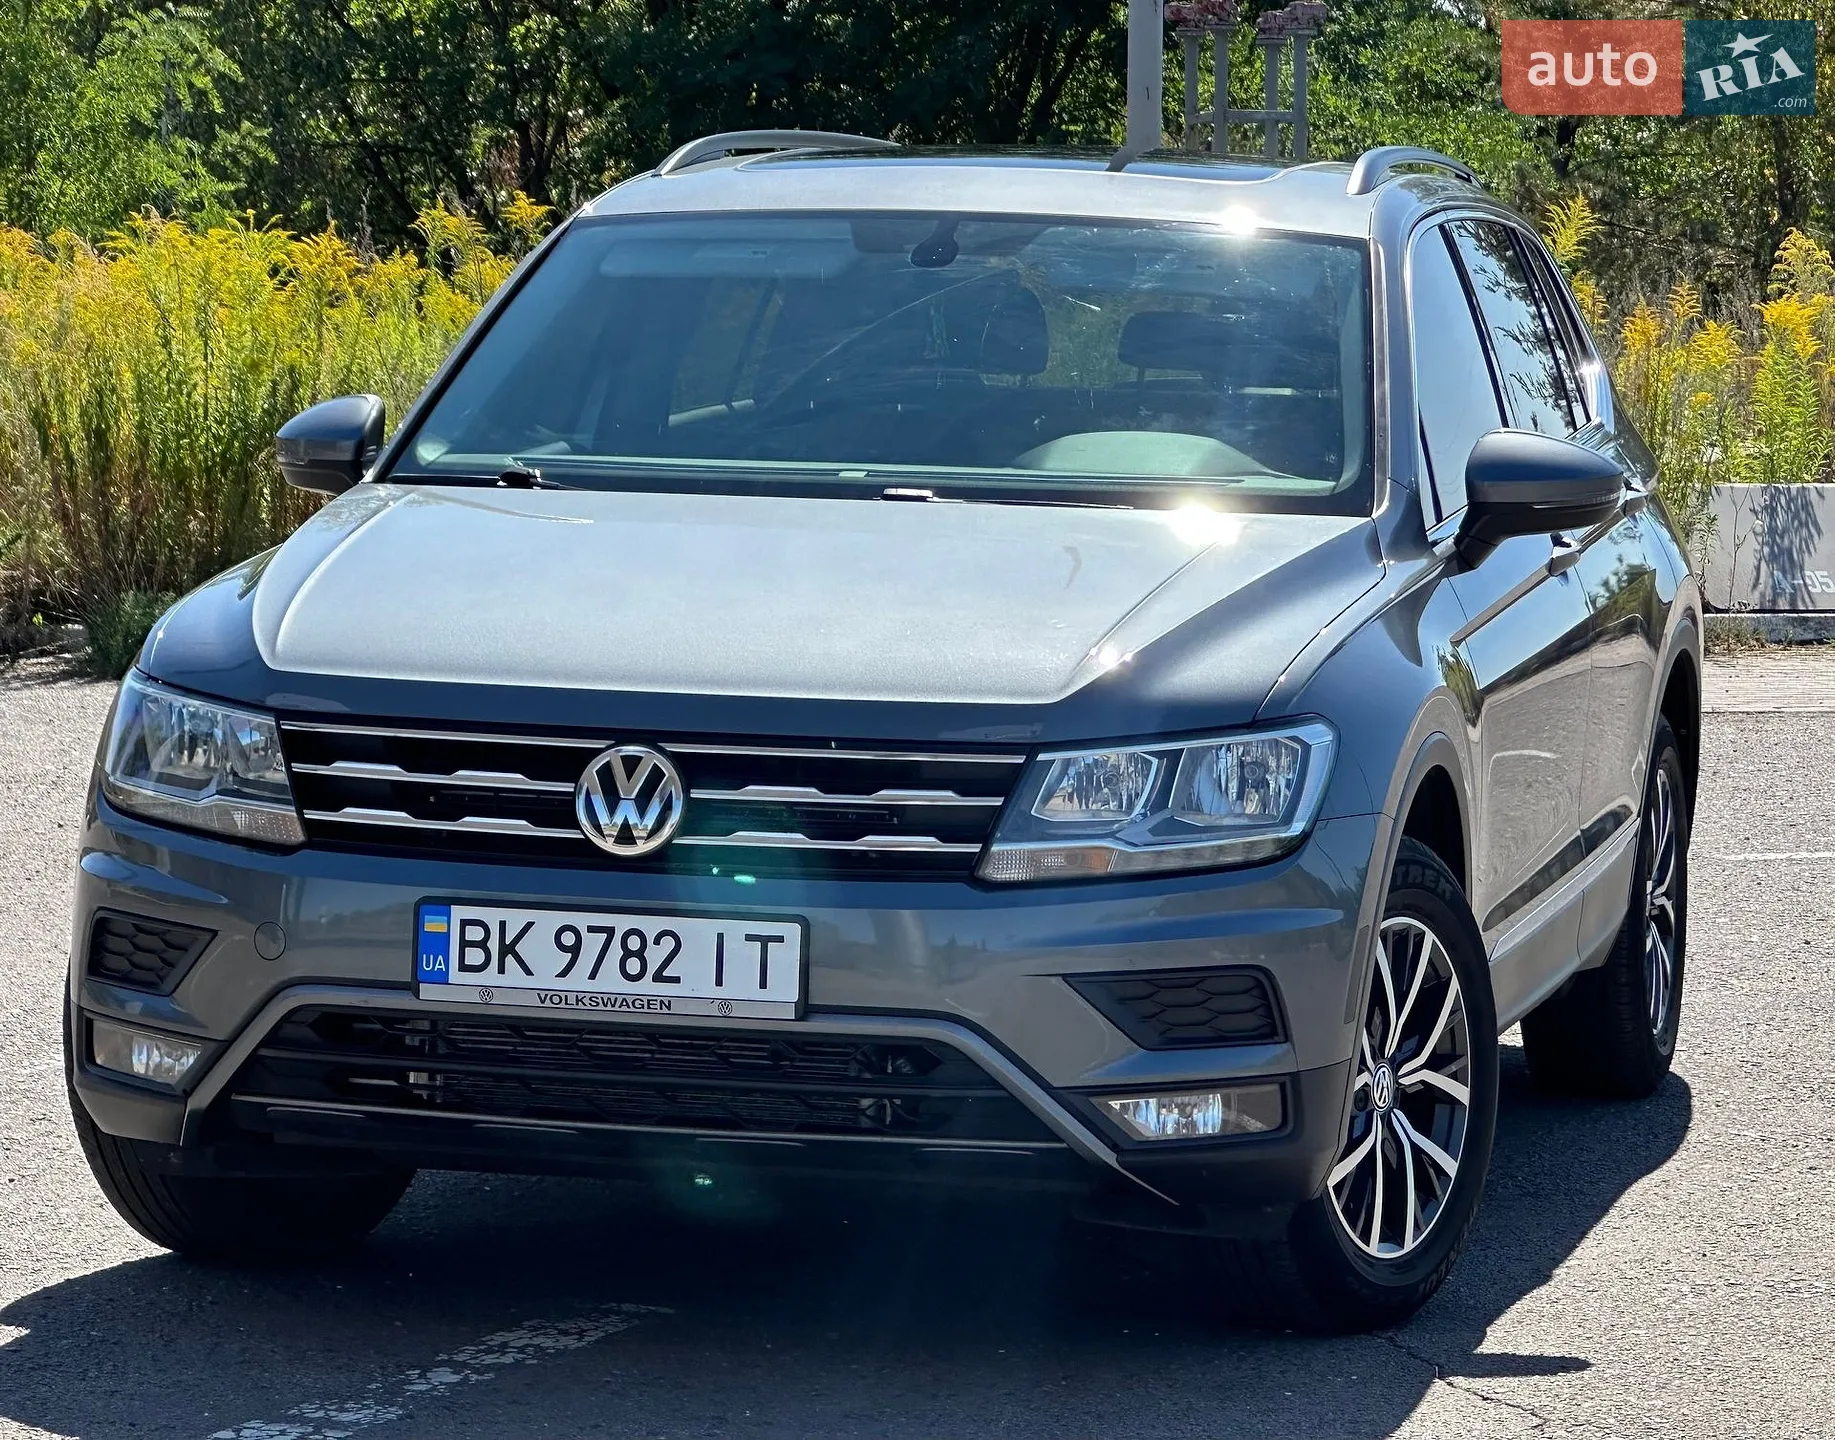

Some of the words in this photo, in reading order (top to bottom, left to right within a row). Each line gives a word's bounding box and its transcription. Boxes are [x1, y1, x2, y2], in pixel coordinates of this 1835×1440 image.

[576, 746, 683, 855] VW
[422, 953, 446, 972] UA
[457, 918, 536, 976] BK
[553, 924, 683, 985] 9782
[714, 932, 785, 990] IT
[536, 992, 673, 1011] VOLKSWAGEN
